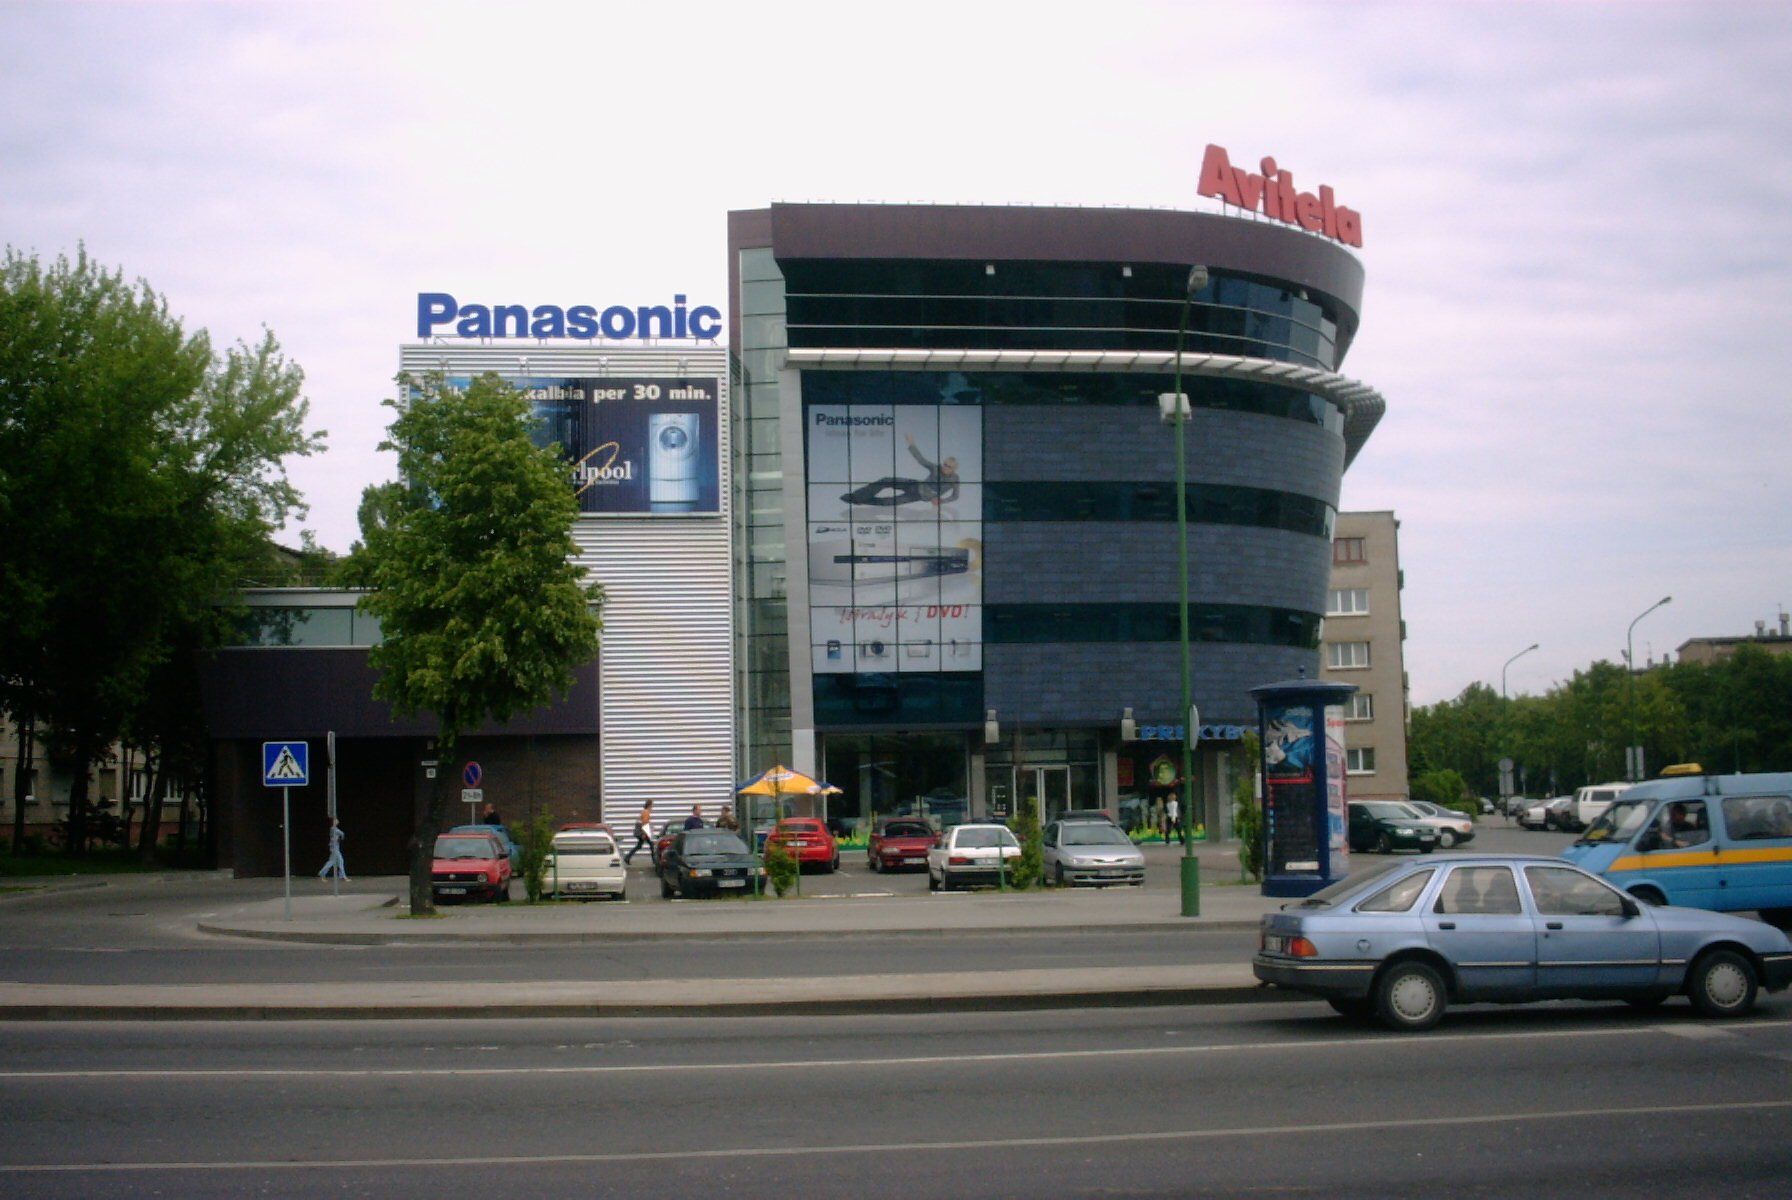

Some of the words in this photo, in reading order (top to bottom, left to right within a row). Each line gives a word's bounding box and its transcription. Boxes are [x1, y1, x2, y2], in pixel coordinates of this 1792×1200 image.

[1197, 143, 1363, 248] Avitela
[417, 292, 722, 340] Panasonic
[593, 387, 626, 404] per
[633, 383, 661, 401] 30
[669, 384, 712, 401] min.
[815, 413, 894, 426] Panasonic
